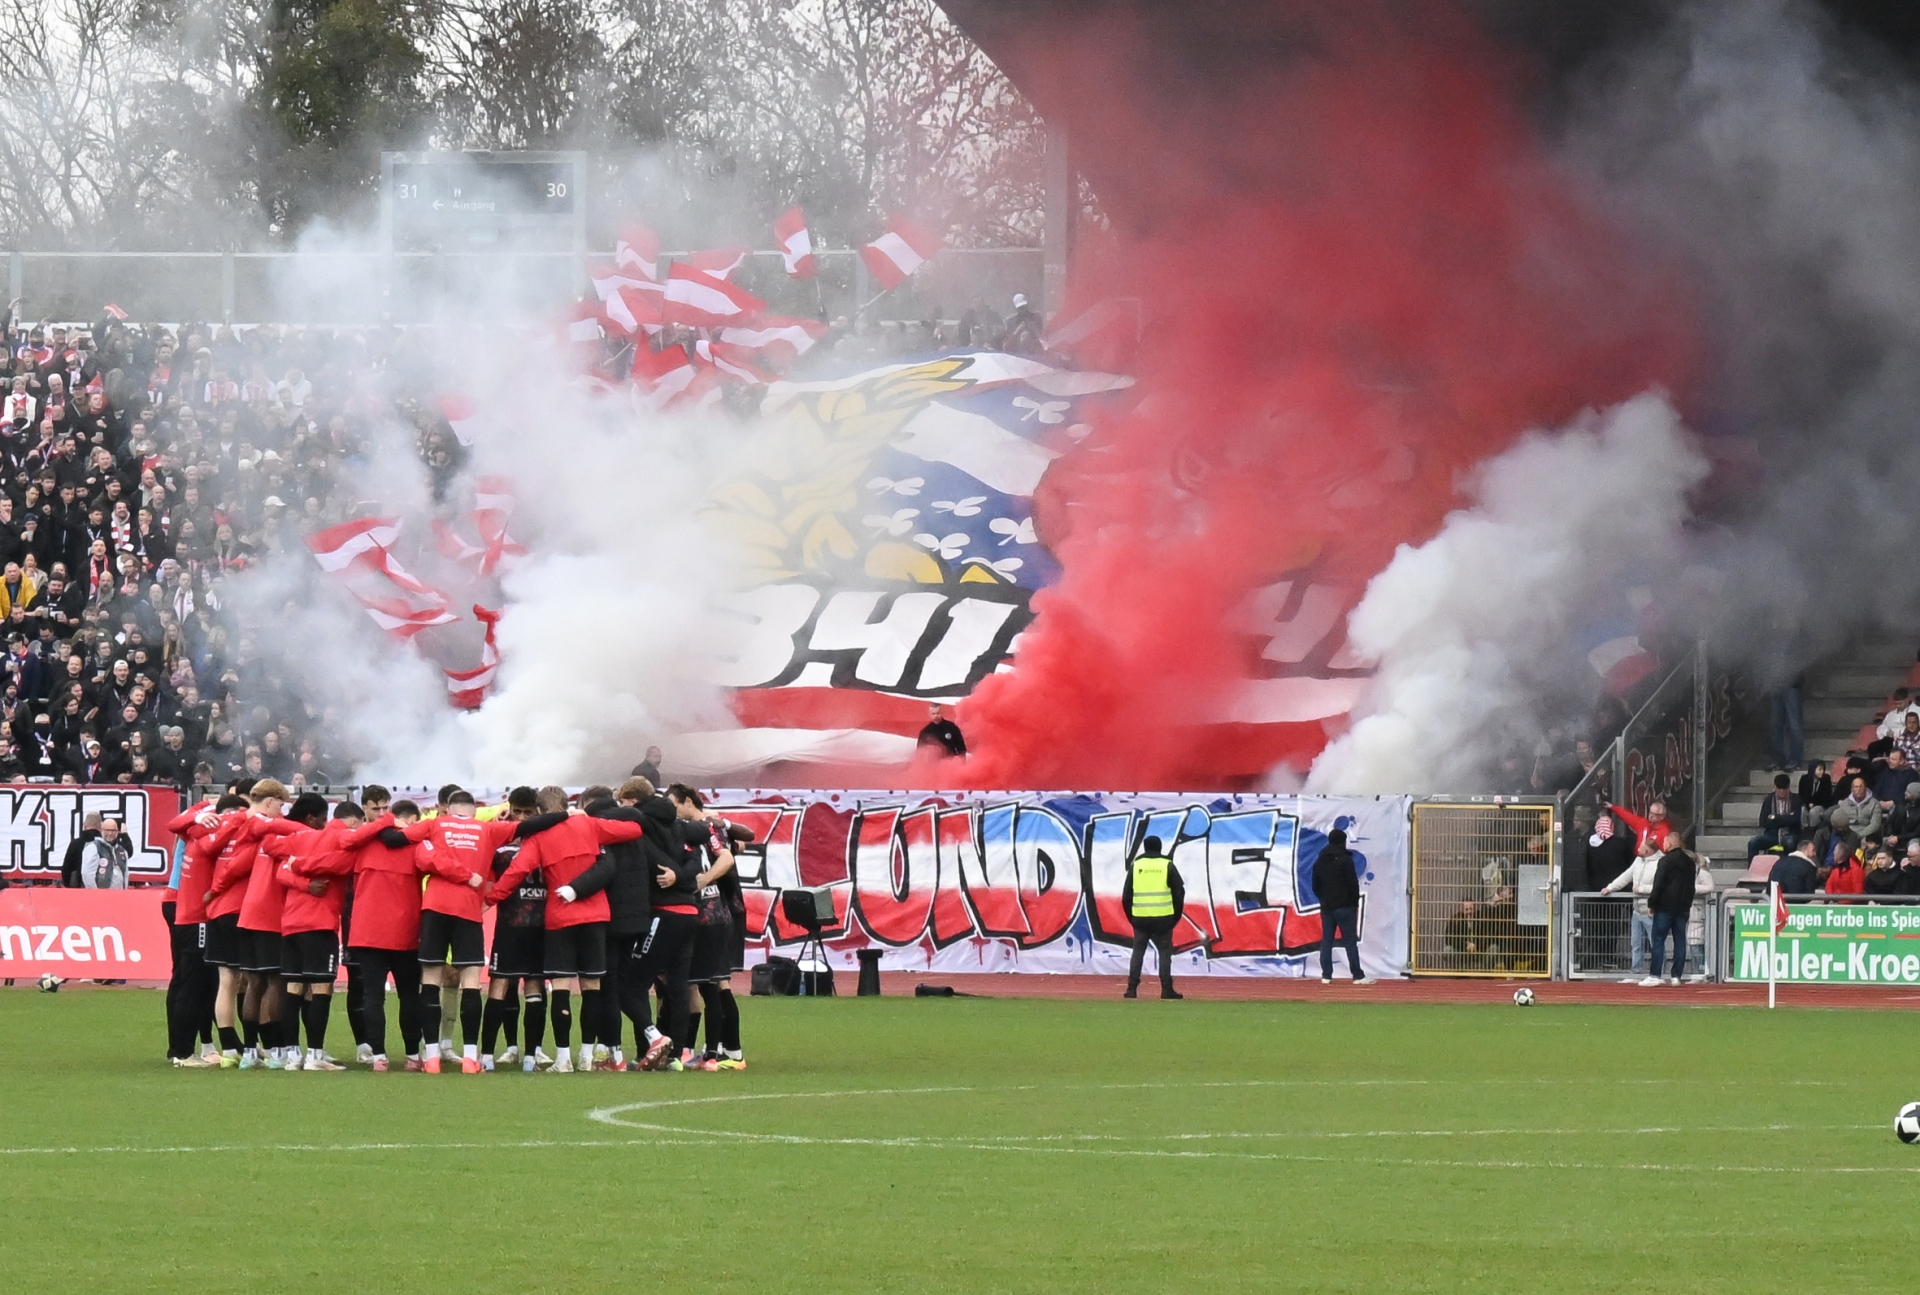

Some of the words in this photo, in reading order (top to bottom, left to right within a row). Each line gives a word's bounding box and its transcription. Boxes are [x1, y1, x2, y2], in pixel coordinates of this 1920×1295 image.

[400, 184, 418, 199] 31
[546, 182, 567, 198] 30
[453, 201, 495, 212] Ausgang
[853, 801, 1085, 951] UND
[1740, 908, 1766, 926] Wir
[1771, 910, 1822, 931] ngen
[1826, 909, 1864, 927] Farbe
[1868, 911, 1888, 928] ins
[1891, 910, 1920, 931] Spie
[1740, 939, 1920, 981] Maler-Kroe
